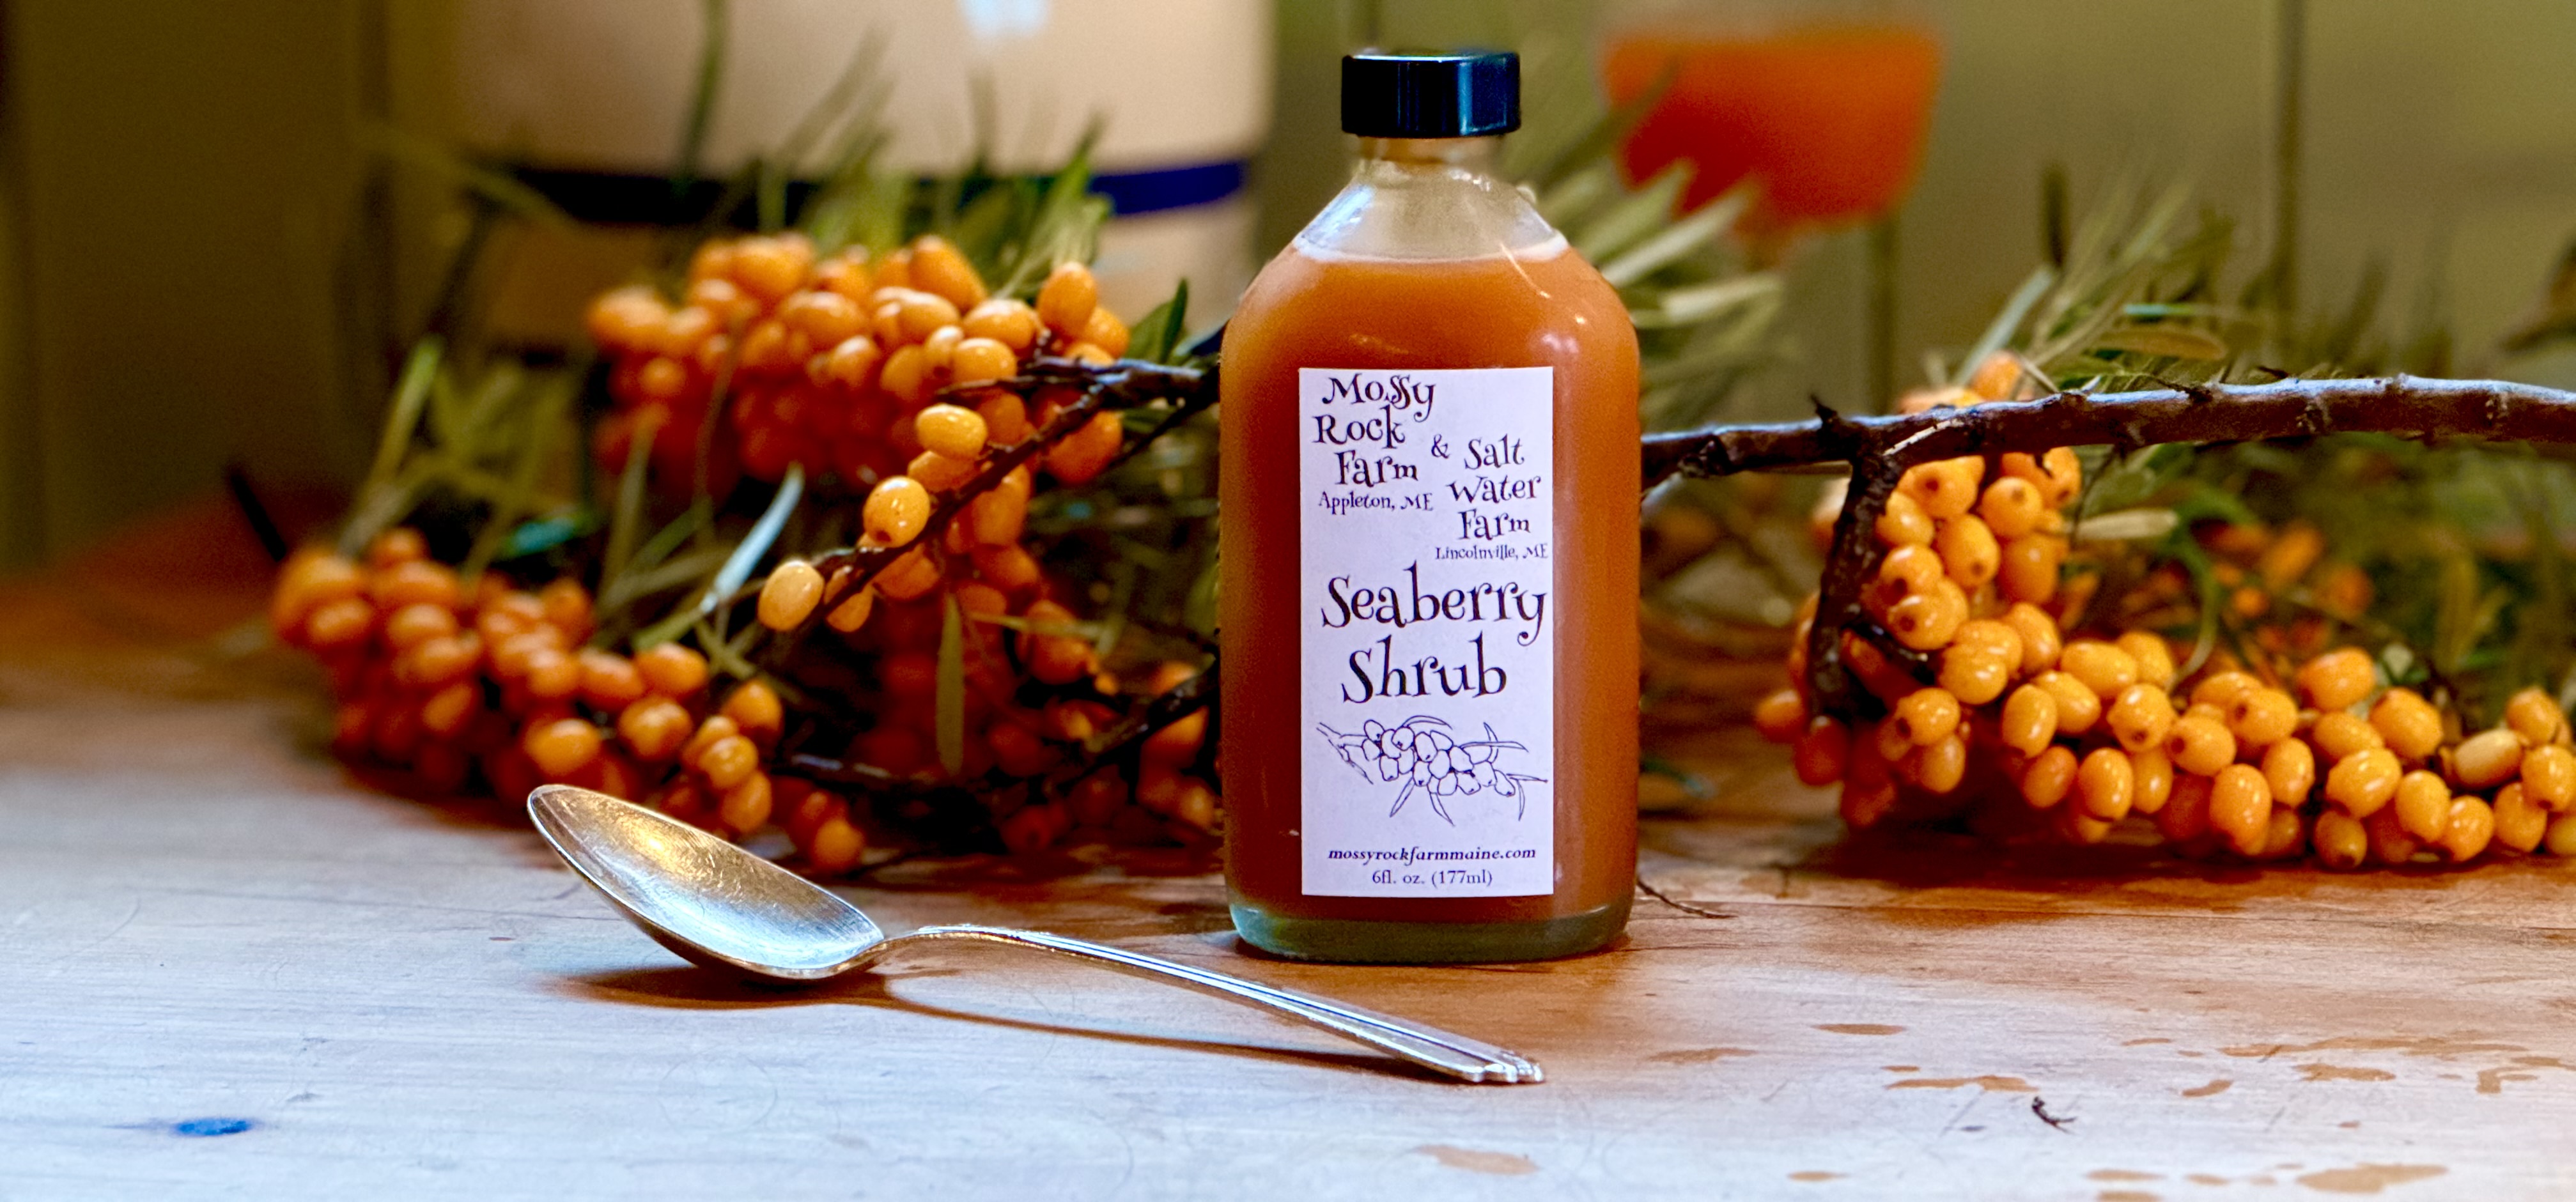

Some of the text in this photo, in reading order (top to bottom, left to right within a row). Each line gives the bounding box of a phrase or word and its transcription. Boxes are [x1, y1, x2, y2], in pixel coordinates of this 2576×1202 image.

[1322, 373, 1436, 422] Mossy
[1312, 405, 1406, 449] Rock
[1334, 450, 1418, 488] Farm
[1431, 434, 1525, 470] & Salt
[1319, 491, 1434, 515] Appleton, ME
[1445, 475, 1541, 504] Water
[1457, 509, 1531, 541] Farm
[1435, 543, 1548, 561] Lincolnville, ME
[1321, 560, 1547, 646] Seaberry
[1341, 630, 1507, 704] Shrub
[1328, 847, 1536, 866] mossyrockfarmmaine.com
[1372, 870, 1493, 888] 6fl. oz. (177ml)
